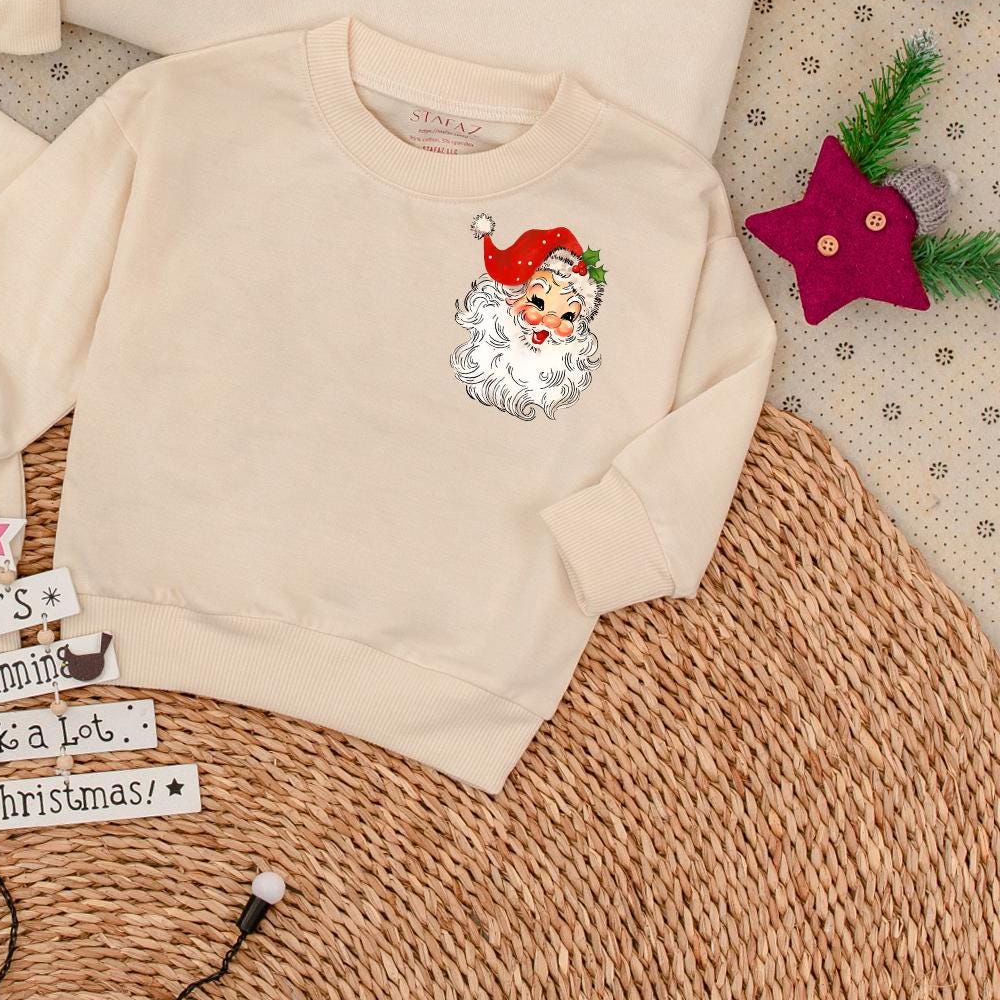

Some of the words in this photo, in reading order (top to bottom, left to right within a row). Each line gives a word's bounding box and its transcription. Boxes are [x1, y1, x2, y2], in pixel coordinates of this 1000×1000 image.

[408, 110, 482, 135] STAFAZ
[28, 724, 49, 750] a
[58, 713, 114, 750] Lot
